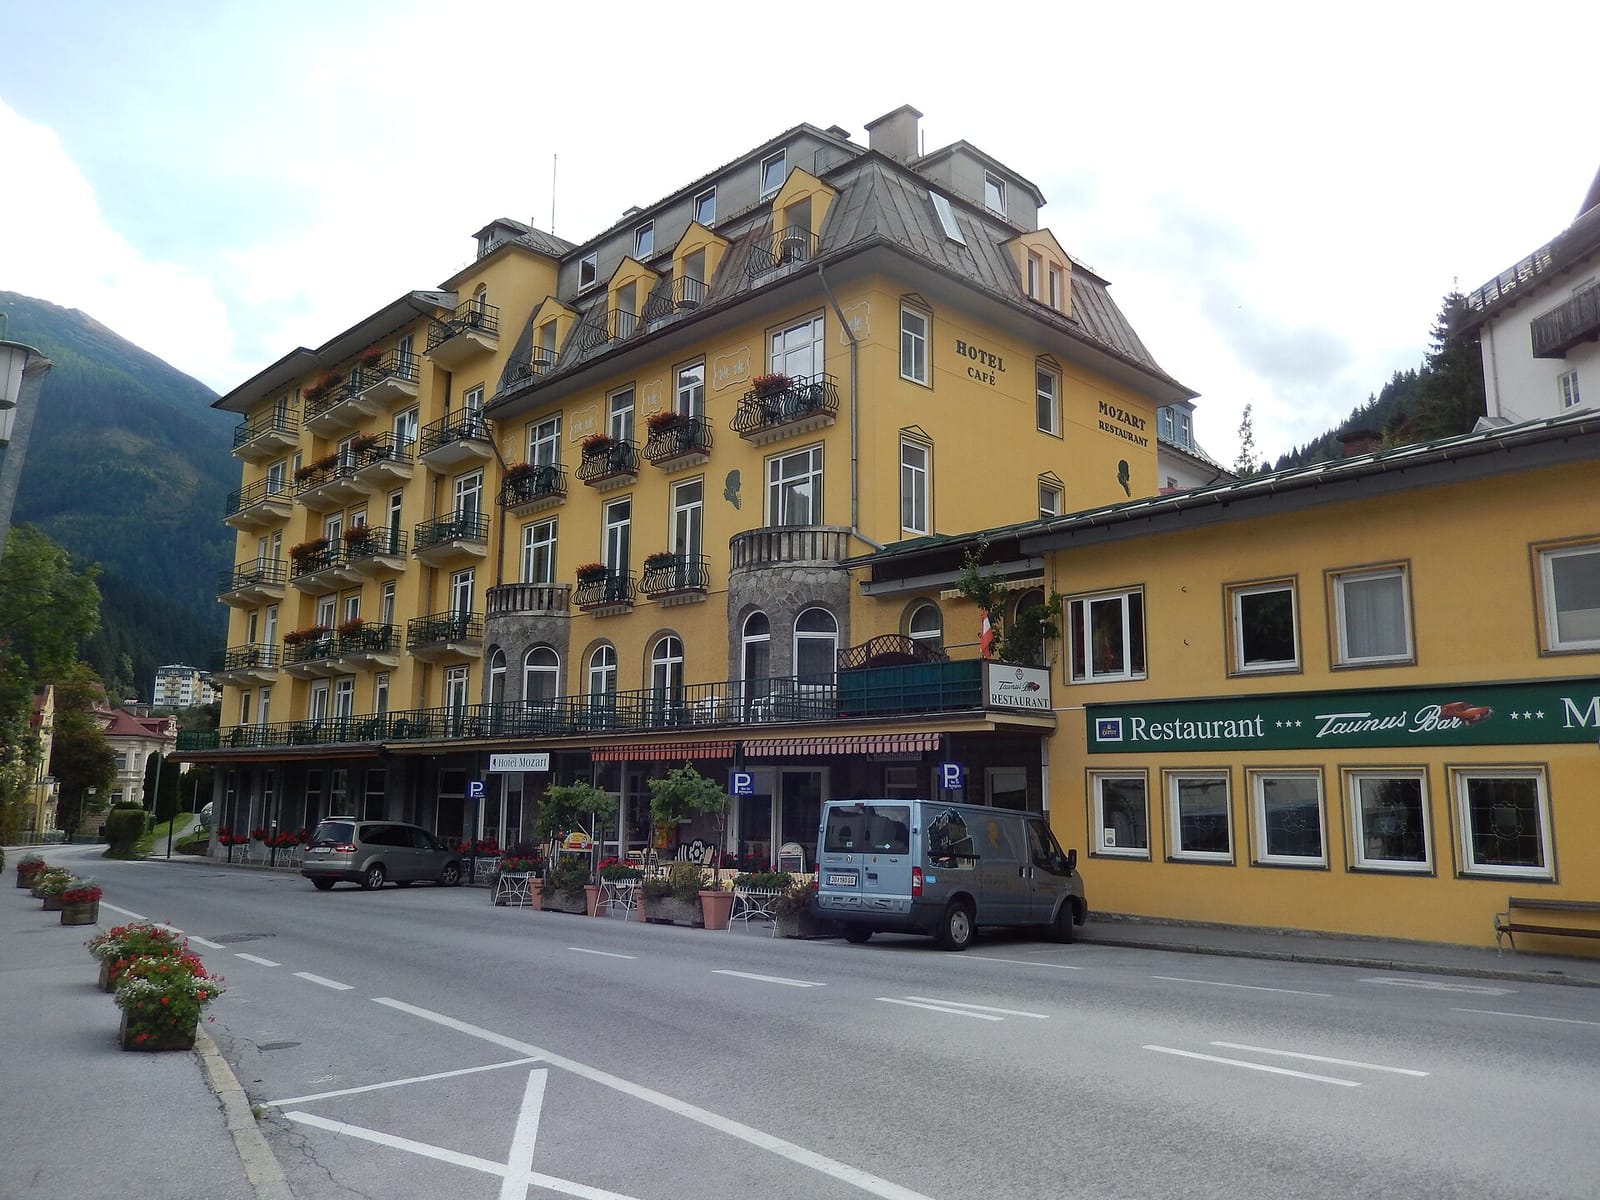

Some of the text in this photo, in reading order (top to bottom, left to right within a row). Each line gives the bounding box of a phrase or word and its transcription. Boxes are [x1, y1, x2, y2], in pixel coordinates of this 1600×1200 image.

[956, 339, 1006, 373] HOTEL
[967, 367, 996, 386] CAFÉ
[1098, 400, 1146, 432] MOZART
[1098, 420, 1149, 448] RESTAURANT
[991, 693, 1049, 708] RESTAURANT
[1129, 713, 1264, 741] Restaurant
[1314, 704, 1463, 738] Taunus Bar
[498, 757, 547, 768] Hotel Mozart
[734, 773, 751, 794] P
[943, 763, 960, 788] P
[470, 781, 484, 798] P
